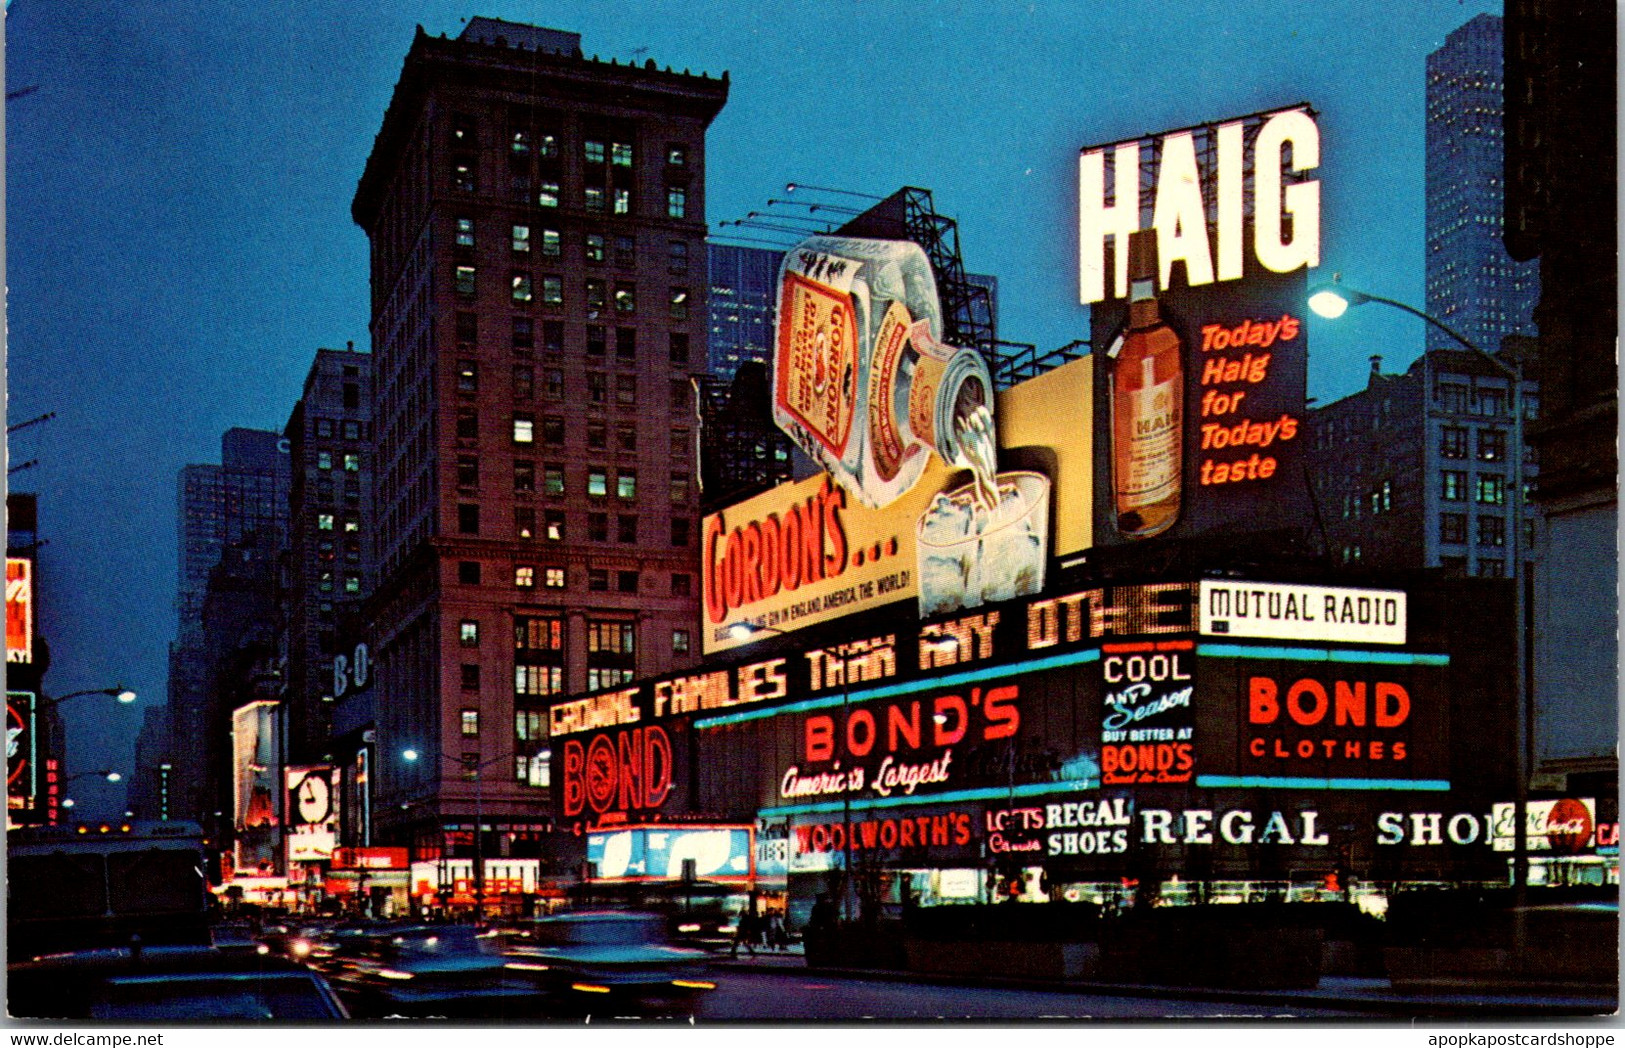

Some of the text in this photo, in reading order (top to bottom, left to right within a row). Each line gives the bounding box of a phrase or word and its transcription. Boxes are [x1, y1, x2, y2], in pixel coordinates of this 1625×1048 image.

[1079, 108, 1321, 305] HAIG
[1202, 314, 1300, 352] Today's
[1201, 353, 1271, 386] Haig
[1201, 389, 1245, 417] for
[1201, 414, 1298, 450] Today's
[1201, 453, 1277, 486] taste
[859, 580, 875, 601] THE
[1210, 588, 1397, 626] MUTUAL RADIO
[655, 658, 787, 717] FAMILIES
[918, 611, 1000, 670] ANY
[1103, 654, 1192, 683] COOL
[1102, 683, 1194, 730] Season
[1249, 676, 1411, 727] BOND
[804, 685, 1021, 762] BOND'S
[1102, 727, 1194, 742] BUY BETTER AT
[1101, 742, 1194, 772] BOND'S
[1249, 737, 1407, 761] CLOTHES
[563, 725, 673, 817] BOND
[871, 749, 953, 796] Largest
[1045, 798, 1131, 829] REGAL
[1139, 808, 1329, 846] REGAL
[795, 812, 971, 854] WOOLWORTH'S
[1047, 828, 1128, 856] SHOES
